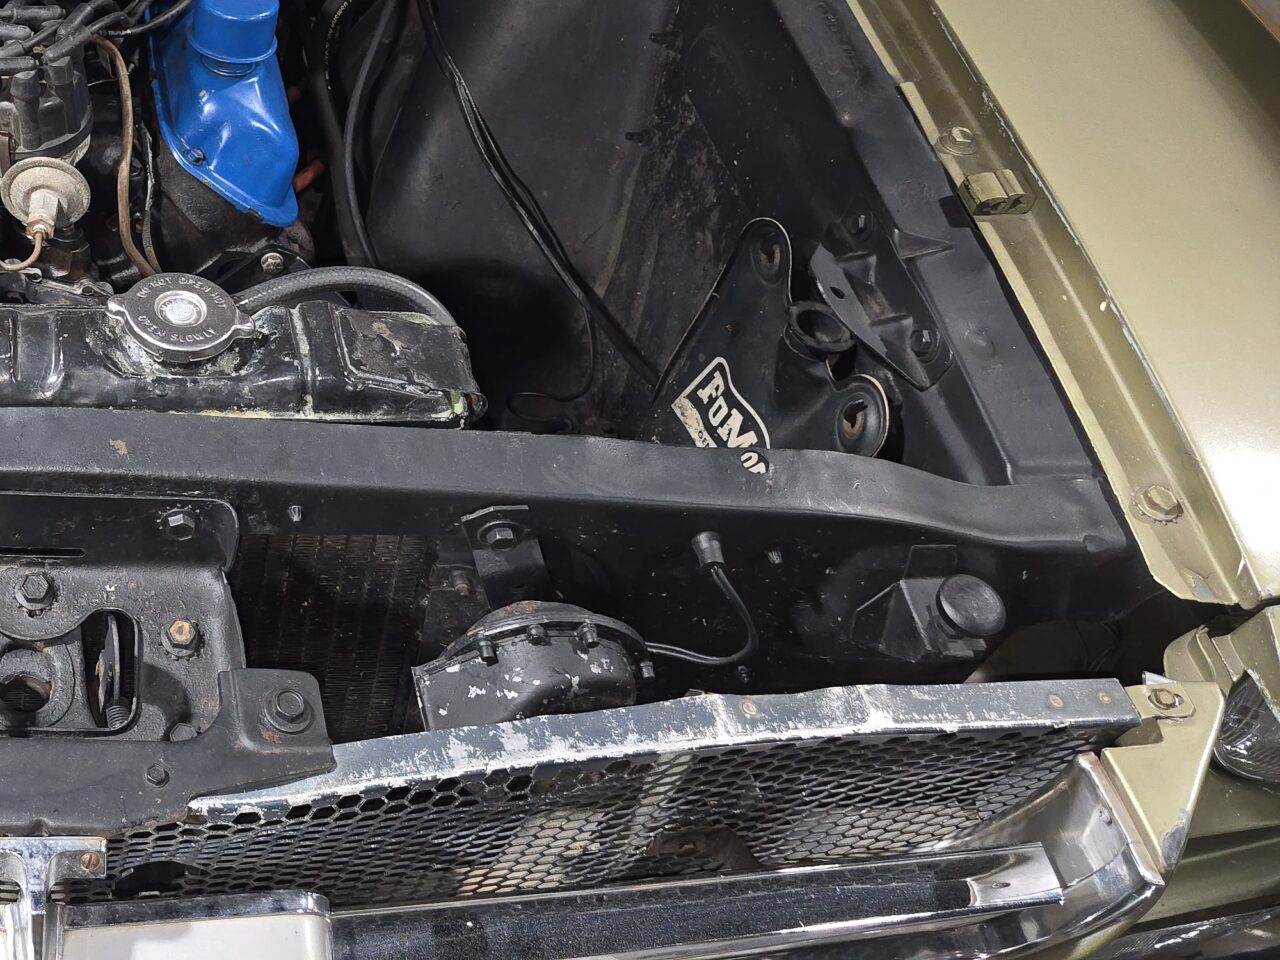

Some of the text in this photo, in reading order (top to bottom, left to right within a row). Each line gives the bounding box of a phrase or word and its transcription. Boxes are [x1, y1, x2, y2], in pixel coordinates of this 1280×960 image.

[136, 287, 151, 298] DO
[149, 276, 172, 288] NOT
[178, 276, 212, 293] OPEN
[210, 292, 228, 311] HOT
[137, 315, 217, 343] OPEN SLOWLY
